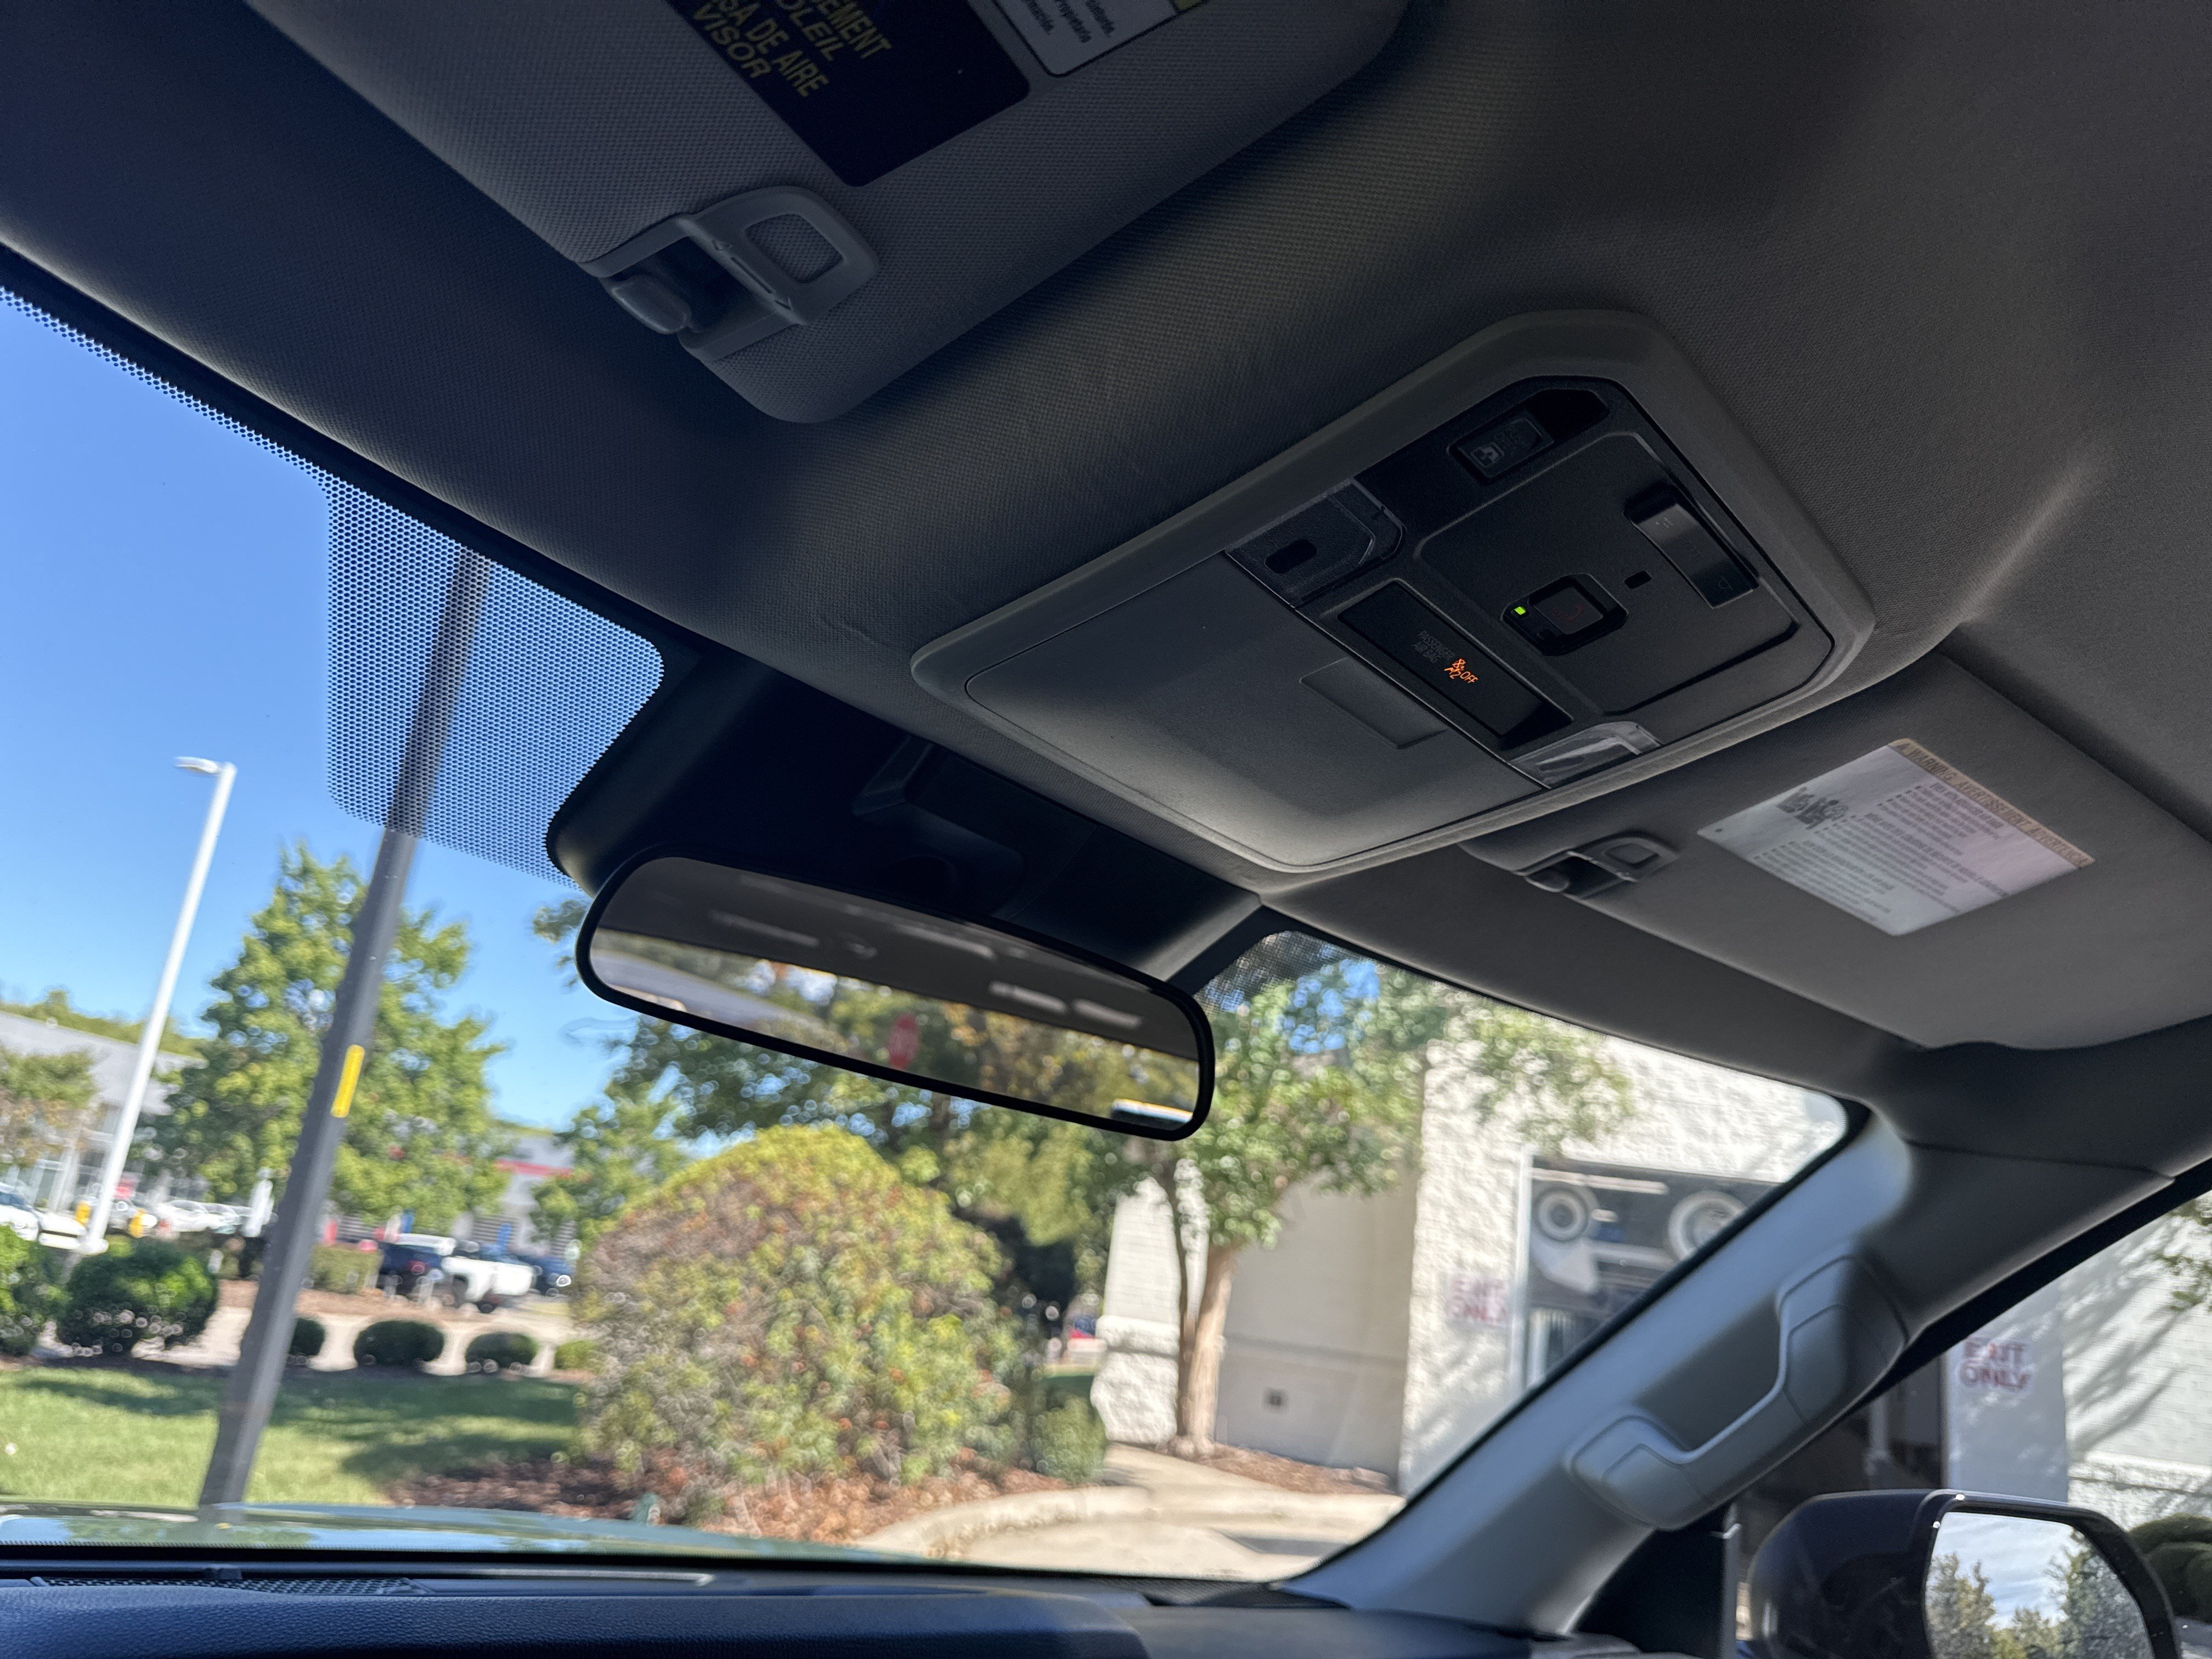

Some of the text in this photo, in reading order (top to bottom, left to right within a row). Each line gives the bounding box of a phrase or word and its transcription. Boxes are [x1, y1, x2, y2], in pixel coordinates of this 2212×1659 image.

[693, 2, 772, 79] VISOR
[812, 0, 893, 59] EMENT
[745, 17, 791, 55] DE
[771, 49, 831, 98] AIRE
[1417, 630, 1455, 661] PASSENGER
[1423, 649, 1441, 663] BAG
[1459, 670, 1479, 684] OFF
[1906, 749, 1957, 781] WARNING
[1959, 1363, 2031, 1392] ONLY
